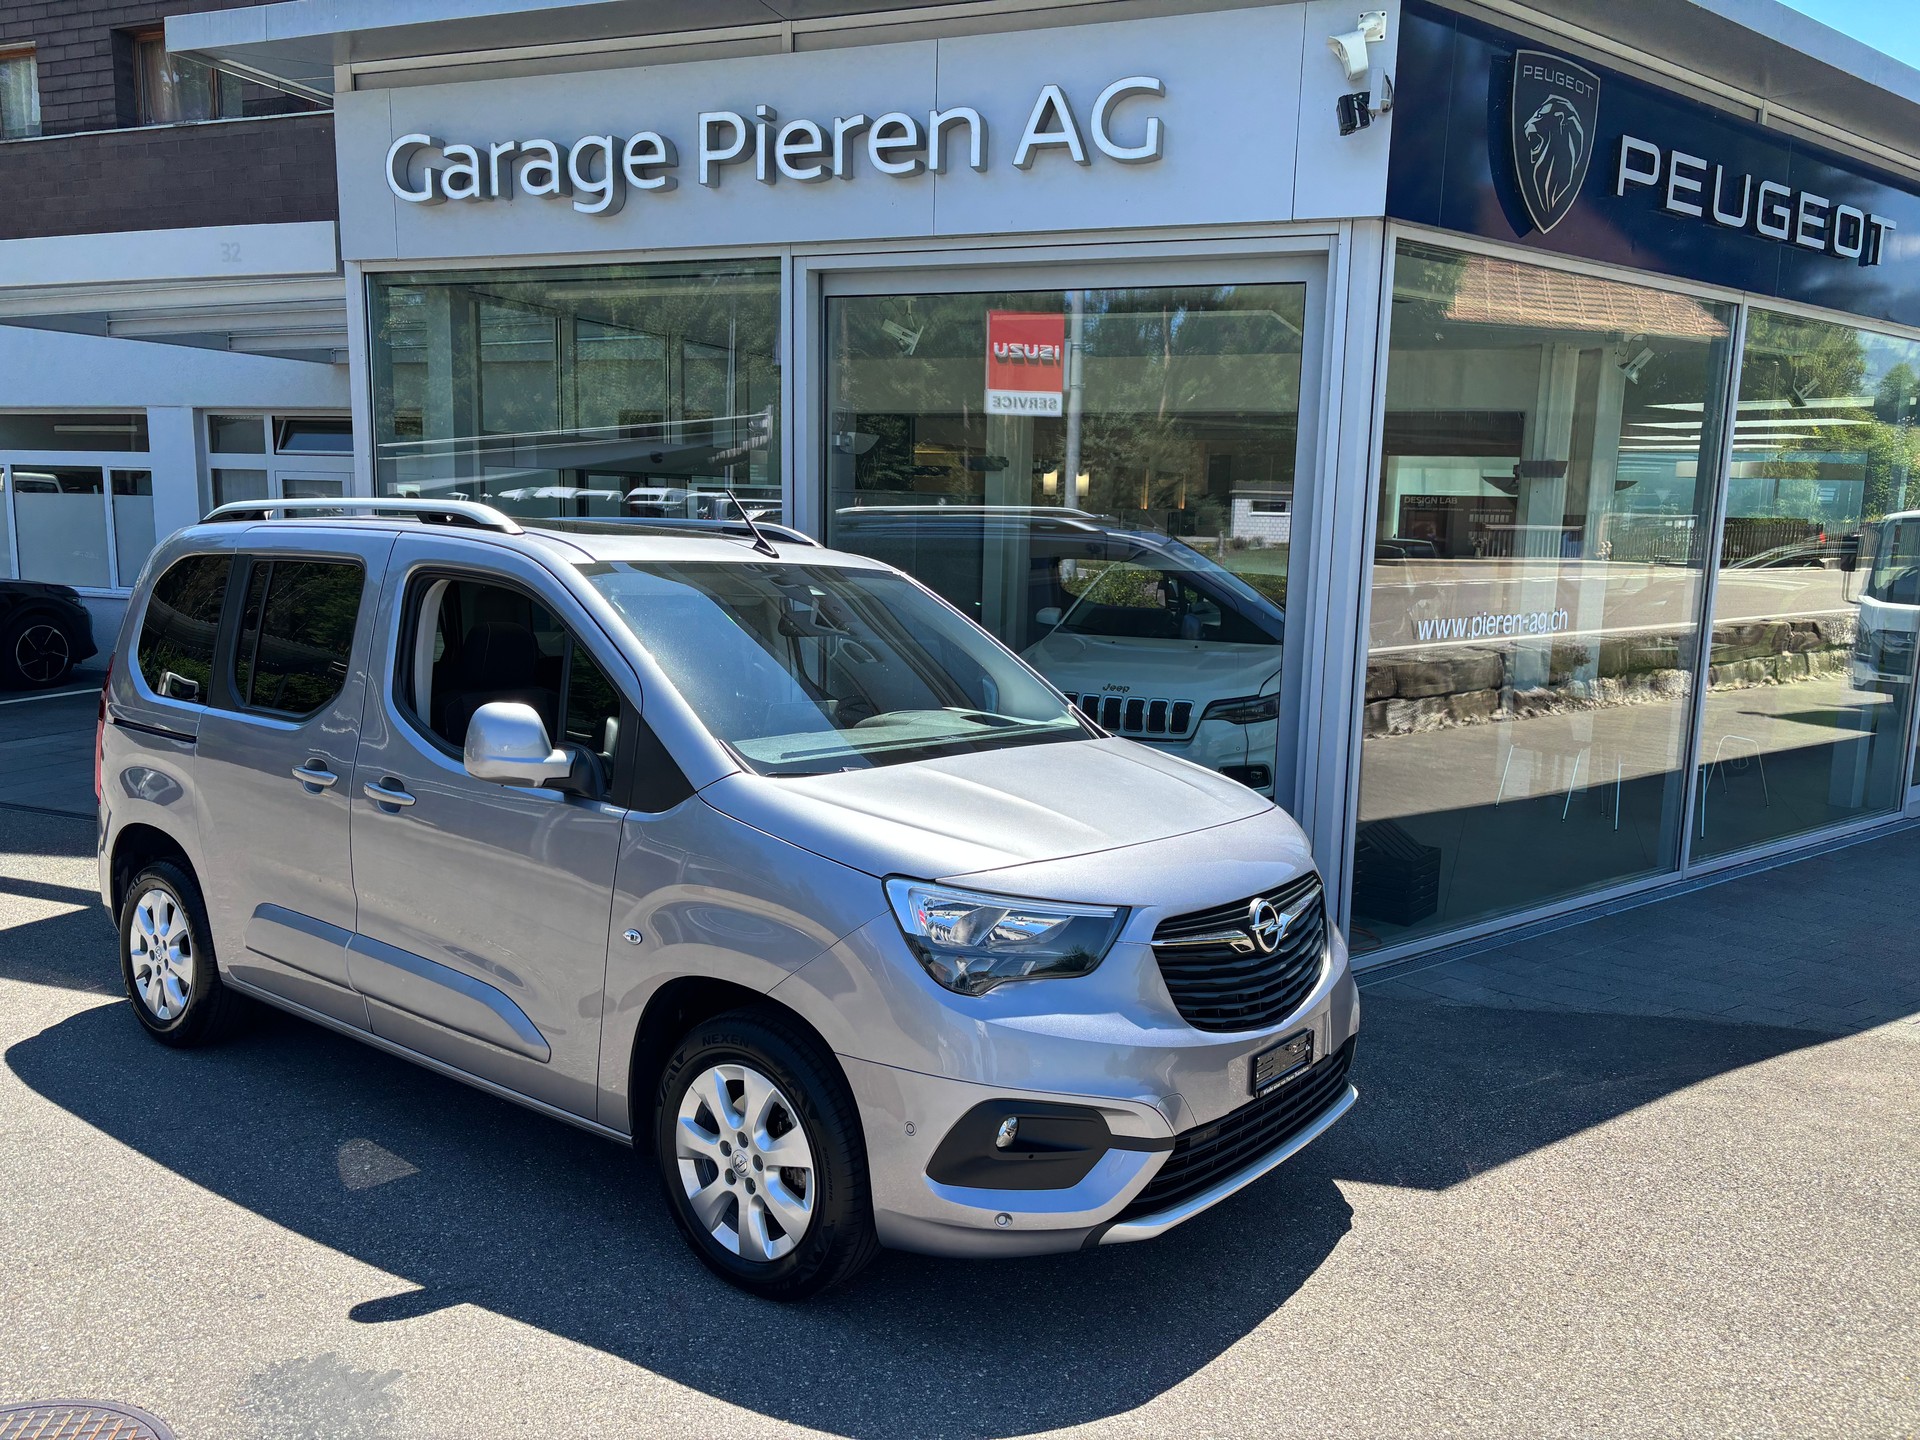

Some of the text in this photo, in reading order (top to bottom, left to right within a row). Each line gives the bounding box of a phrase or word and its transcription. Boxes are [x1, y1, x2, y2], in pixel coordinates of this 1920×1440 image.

[1523, 65, 1594, 98] PEUGEOT
[385, 76, 1164, 216] Garage Pieren AG
[1616, 134, 1897, 266] PEUGEOT
[220, 242, 242, 263] 32
[1404, 496, 1458, 505] DESIGN LAB
[1417, 608, 1568, 641] www.pieren-ag.ch
[1102, 683, 1130, 693] Jeep
[702, 1033, 750, 1049] NEXEN
